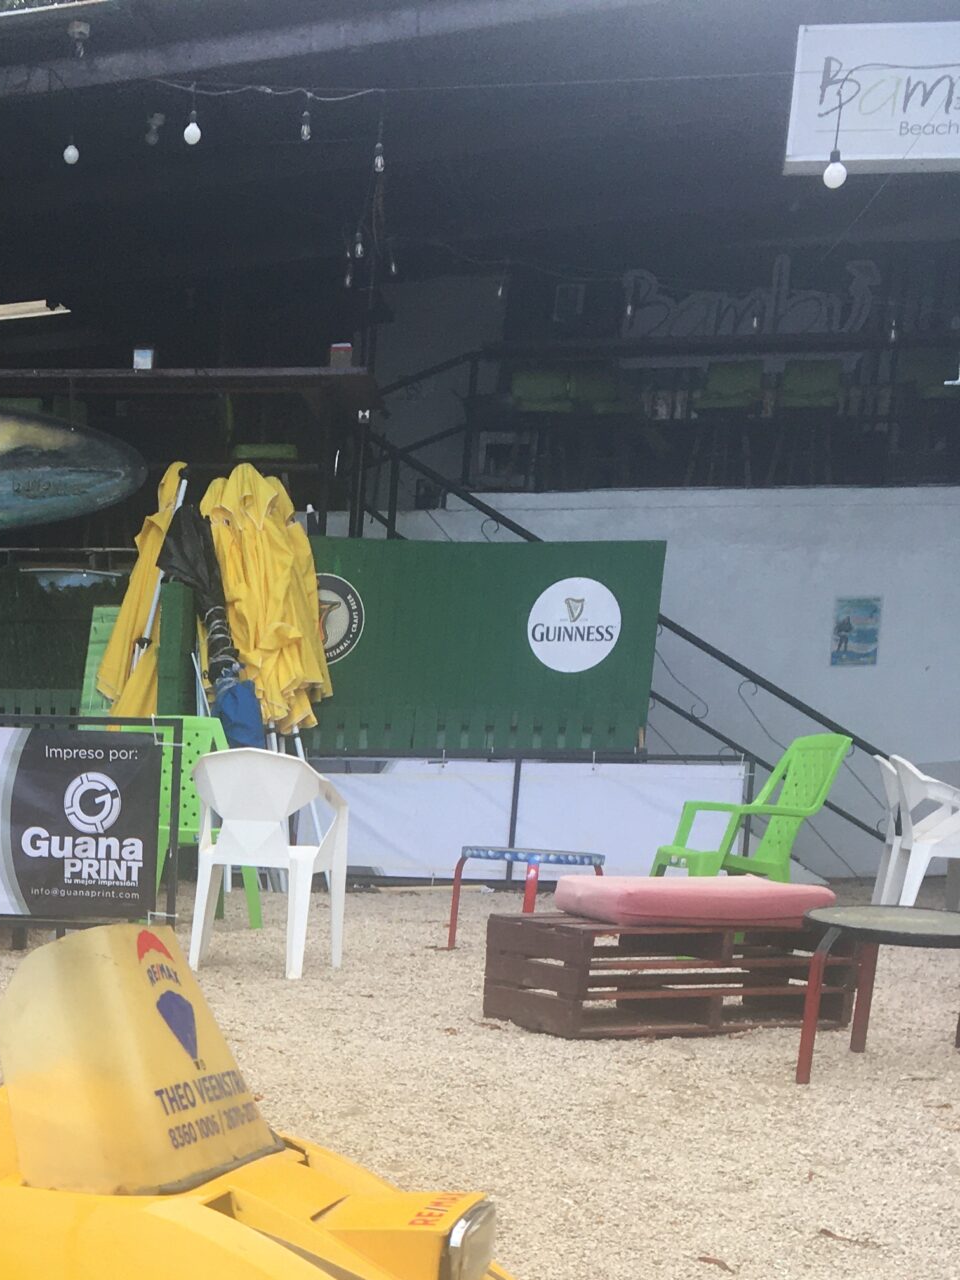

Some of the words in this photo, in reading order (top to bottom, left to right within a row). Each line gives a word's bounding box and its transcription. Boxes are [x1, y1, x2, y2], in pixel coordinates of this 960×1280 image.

[899, 119, 959, 136] Beach
[531, 623, 615, 642] GUINNESS
[326, 639, 351, 658] TESANAL
[45, 745, 104, 761] Impreso
[109, 748, 138, 762] por:
[21, 826, 143, 860] Guana
[64, 859, 143, 881] PRINT
[30, 887, 140, 899] info@guanaprint.com
[146, 963, 181, 986] RE/MAX
[154, 1081, 197, 1116] THEO
[168, 1121, 198, 1149] 8360
